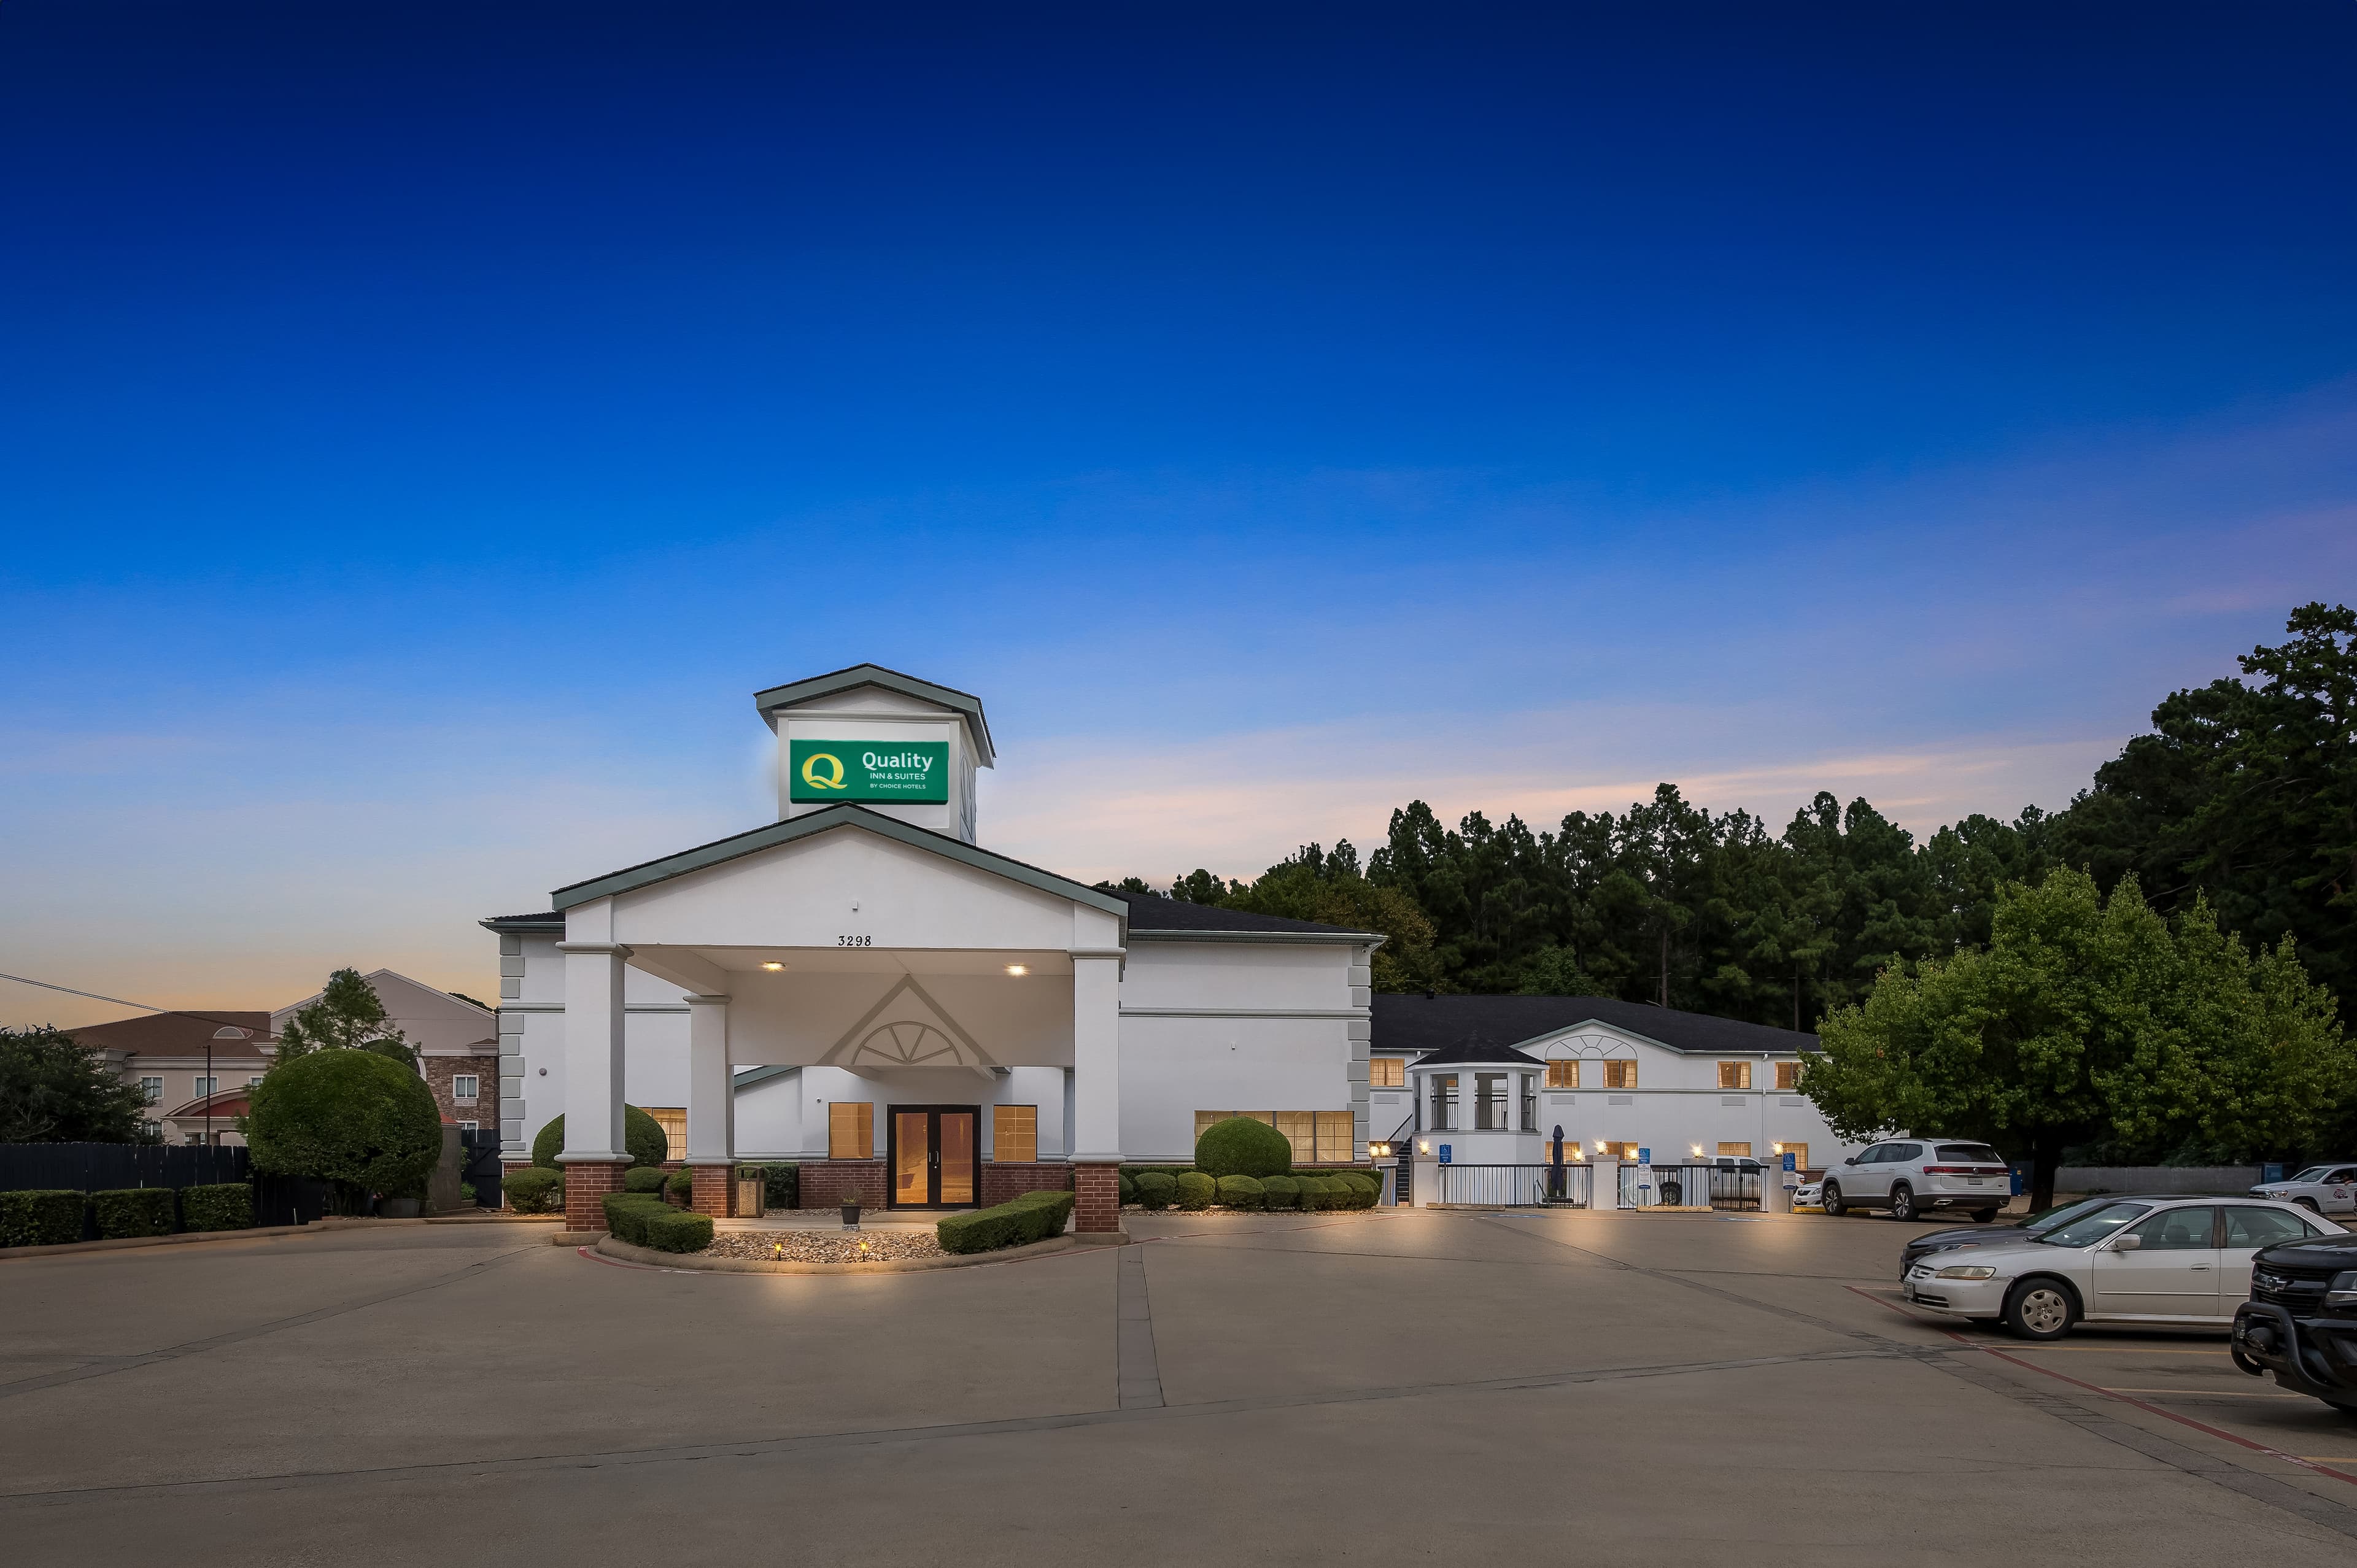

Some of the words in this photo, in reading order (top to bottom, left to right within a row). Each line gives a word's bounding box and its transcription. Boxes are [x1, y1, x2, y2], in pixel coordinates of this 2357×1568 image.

[802, 753, 848, 789] Q
[862, 752, 933, 771] Quality
[838, 935, 871, 946] 3298
